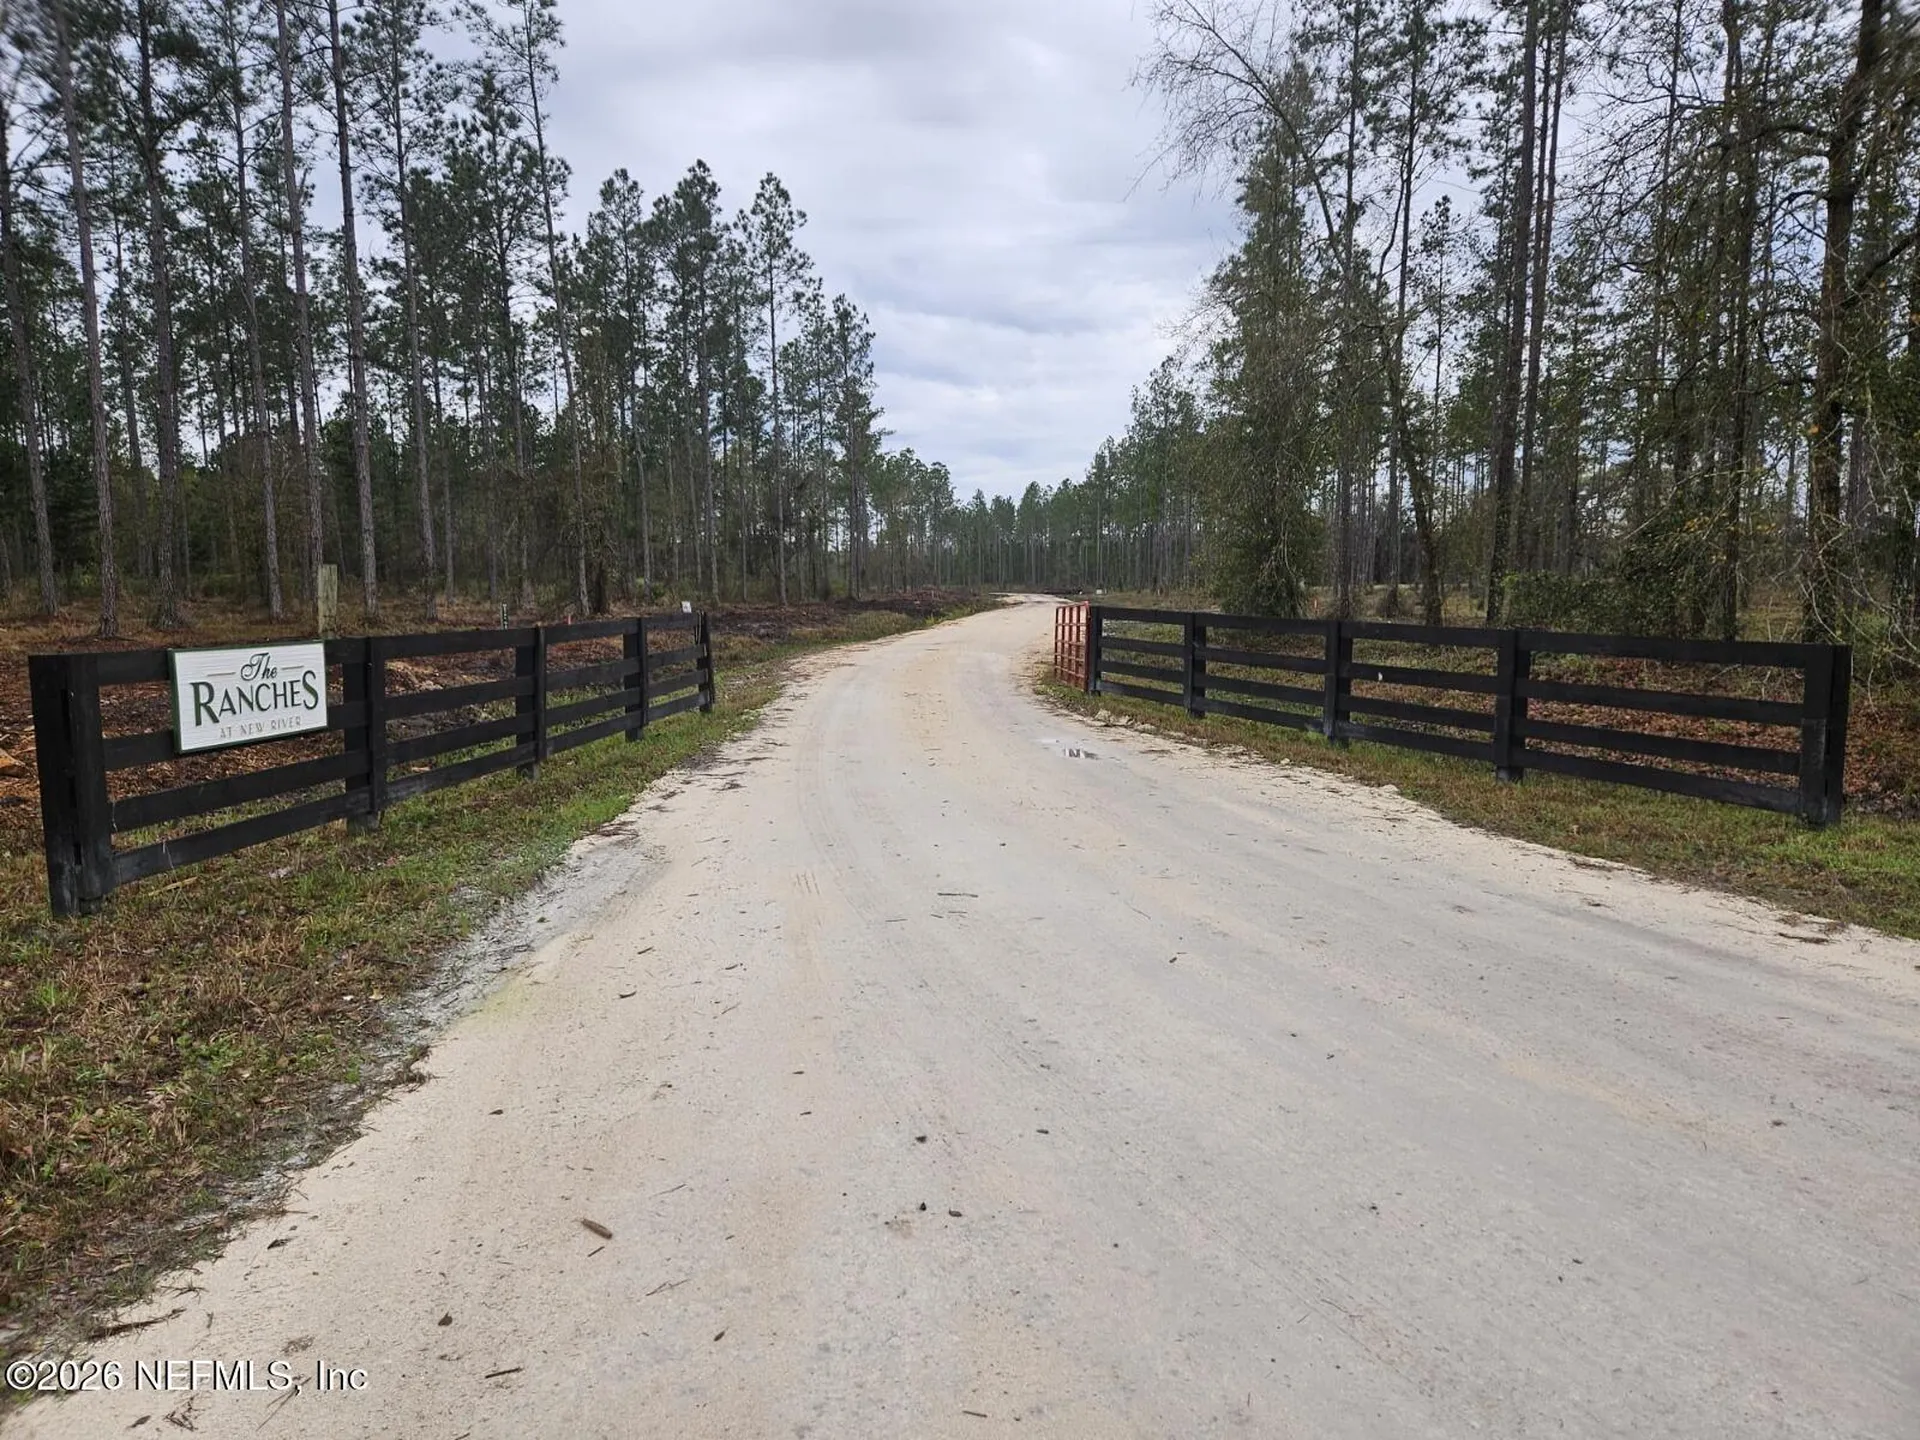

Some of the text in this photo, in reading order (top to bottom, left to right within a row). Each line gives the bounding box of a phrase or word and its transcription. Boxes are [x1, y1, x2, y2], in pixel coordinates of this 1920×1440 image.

[240, 652, 278, 681] The
[189, 670, 319, 726] RANCHES
[220, 716, 302, 739] AT NEW RIVER
